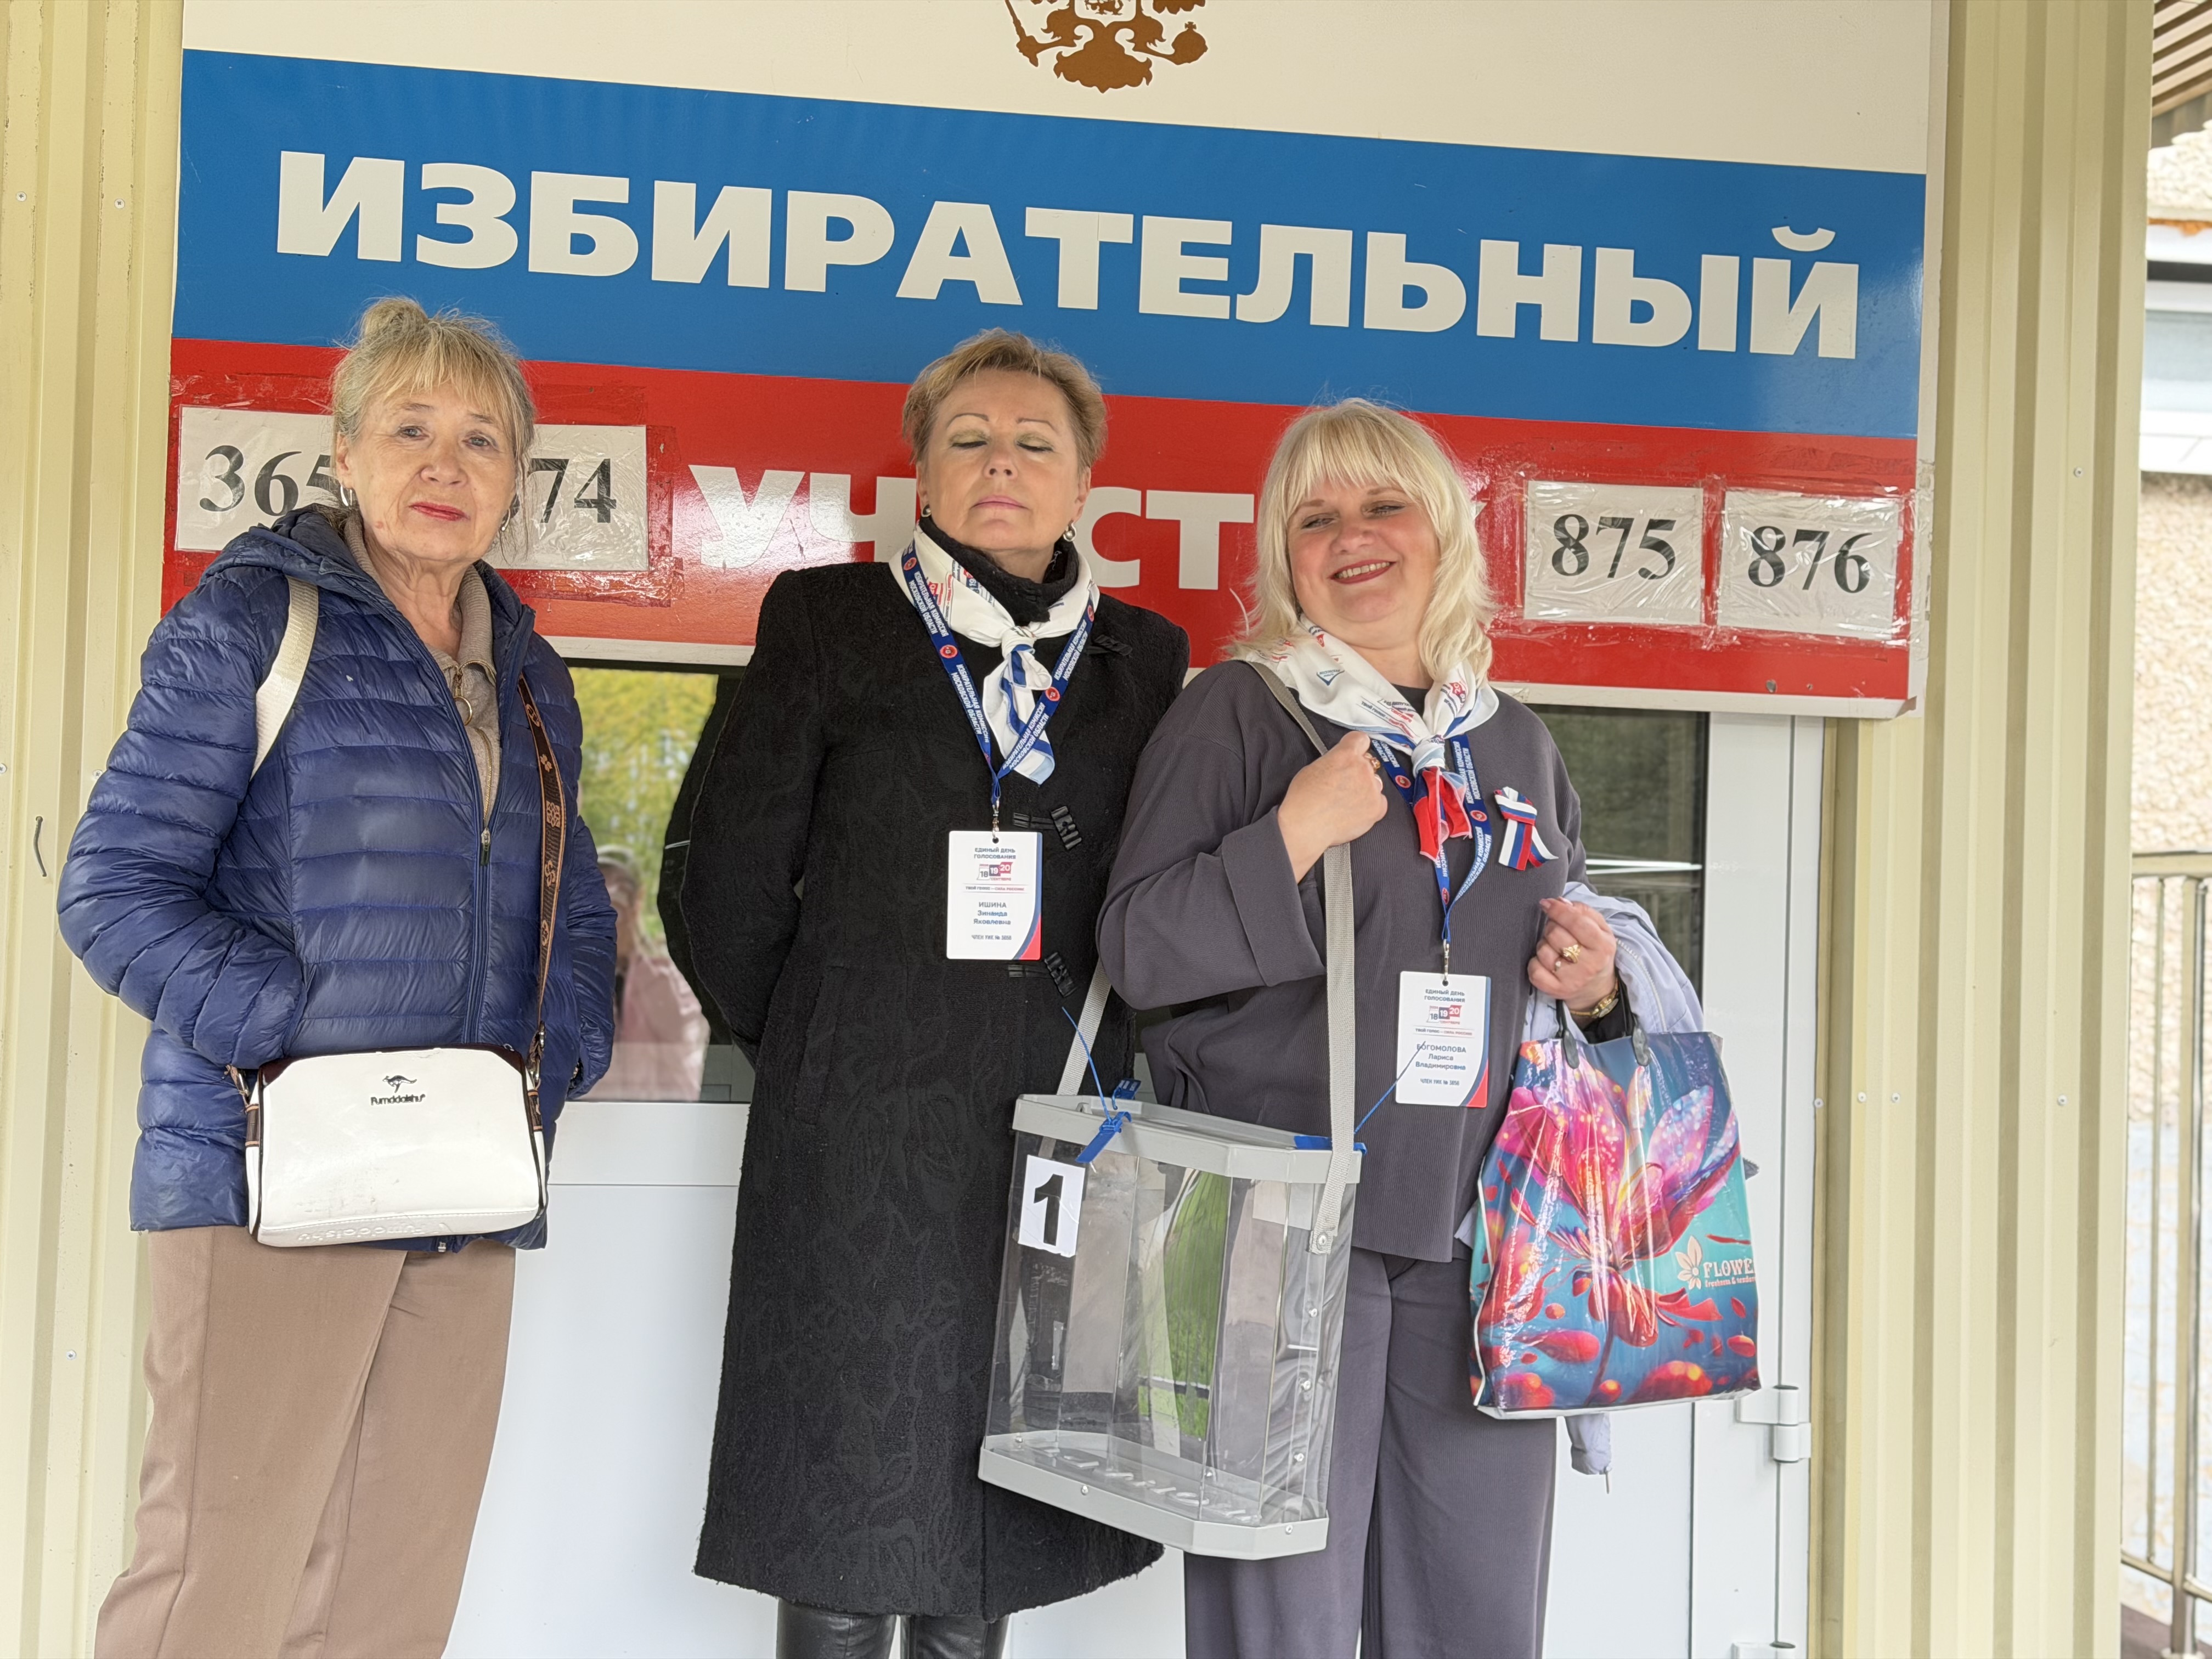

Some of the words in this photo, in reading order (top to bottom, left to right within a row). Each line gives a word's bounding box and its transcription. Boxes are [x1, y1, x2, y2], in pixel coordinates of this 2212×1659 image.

[277, 151, 1859, 359] ИЗБИРАТЕЛЬНЫЙ
[503, 458, 617, 523] 74
[688, 465, 1487, 590] УЧСТ
[1551, 514, 1677, 580] 875
[1748, 525, 1873, 594] 876
[922, 612, 939, 635] ОБЛАСТИ
[930, 605, 949, 637] КОМИССИЯ
[956, 664, 980, 709] ИЗБИРАТЕЛЬНАЯ
[951, 672, 972, 709] МОСКОВСКОЙ
[967, 708, 982, 735] ОБЛАСТИ
[1002, 727, 1031, 770] ИЗБИРАТЕЛЬНАЯ
[1029, 702, 1046, 731] КОМИССИЯ
[1009, 735, 1036, 770] МОСКОВСКОЙ
[1032, 713, 1049, 737] ОБЛАСТИ
[1372, 740, 1389, 762] ОБЛАСТИ
[1453, 741, 1465, 768] КОМИССИЯ
[1463, 748, 1473, 769] ОБЛАСТИ
[1466, 769, 1481, 799] МОСКОВСКОЙ
[1475, 826, 1484, 857] КОМИССИЯ
[1482, 834, 1492, 863] ОБЛАСТИ
[1440, 845, 1448, 877] ОМИССИЯ
[1417, 1044, 1466, 1053] БОГОМОЛОВА
[1415, 1061, 1466, 1070] Владимировна
[1034, 1173, 1064, 1246] 1
